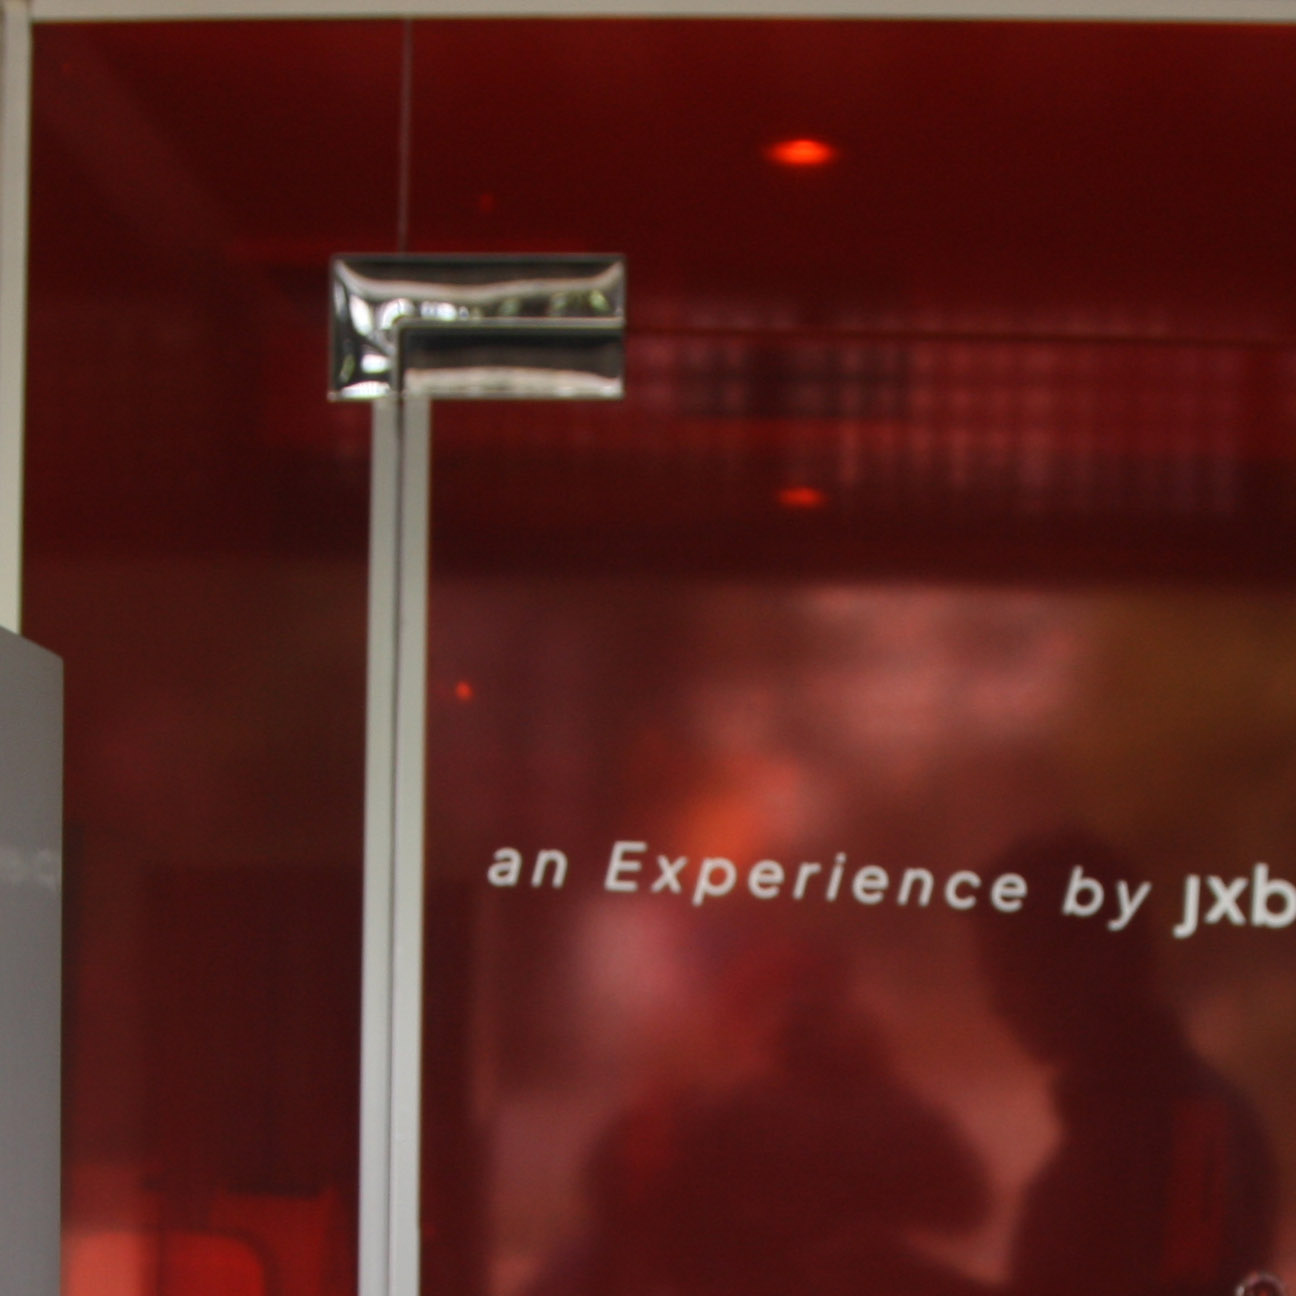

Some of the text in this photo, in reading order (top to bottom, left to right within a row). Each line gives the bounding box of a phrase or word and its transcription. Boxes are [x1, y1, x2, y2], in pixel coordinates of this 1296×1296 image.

[487, 845, 568, 888] an
[603, 841, 1029, 914] Experience
[1061, 865, 1151, 931] by
